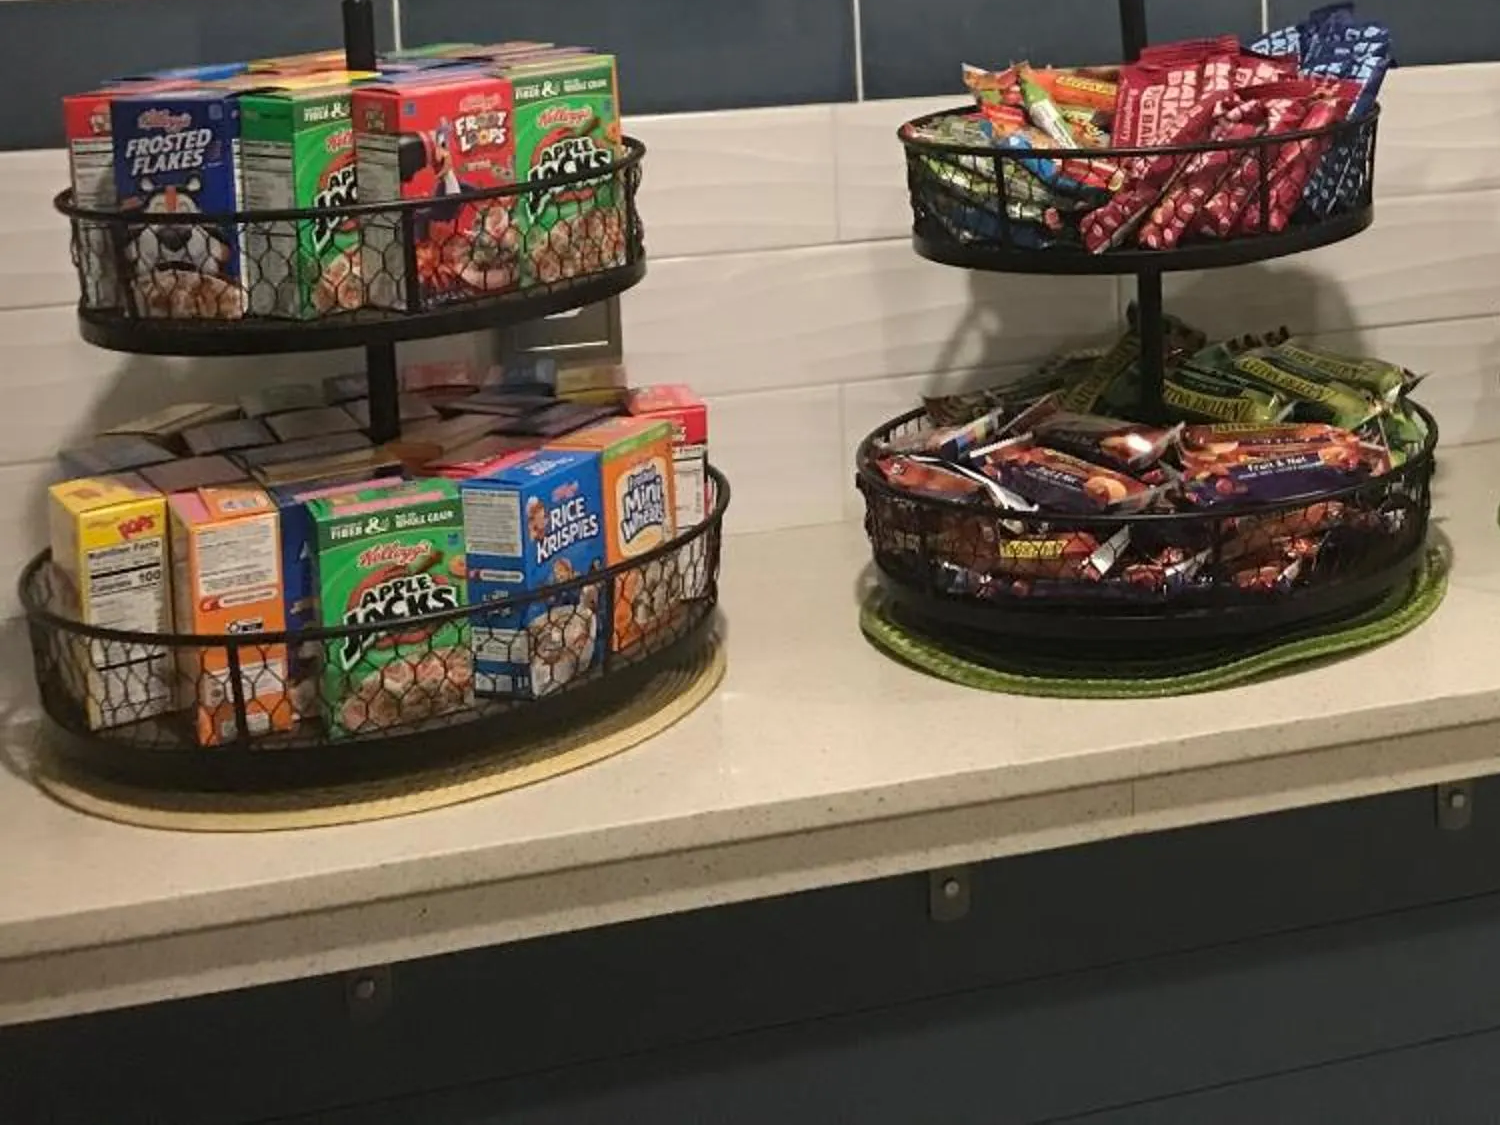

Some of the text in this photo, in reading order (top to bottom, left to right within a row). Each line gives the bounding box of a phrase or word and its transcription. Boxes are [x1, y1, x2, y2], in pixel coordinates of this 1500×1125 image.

[125, 128, 212, 159] FROSTED
[540, 136, 596, 165] APPLE
[131, 149, 205, 177] FLAKES
[550, 496, 585, 532] RICE
[624, 475, 663, 521] Mini
[357, 539, 433, 568] Kellogg's
[536, 514, 599, 564] KRISPIES
[360, 573, 434, 609] APPLE
[341, 586, 459, 671] JACKS
